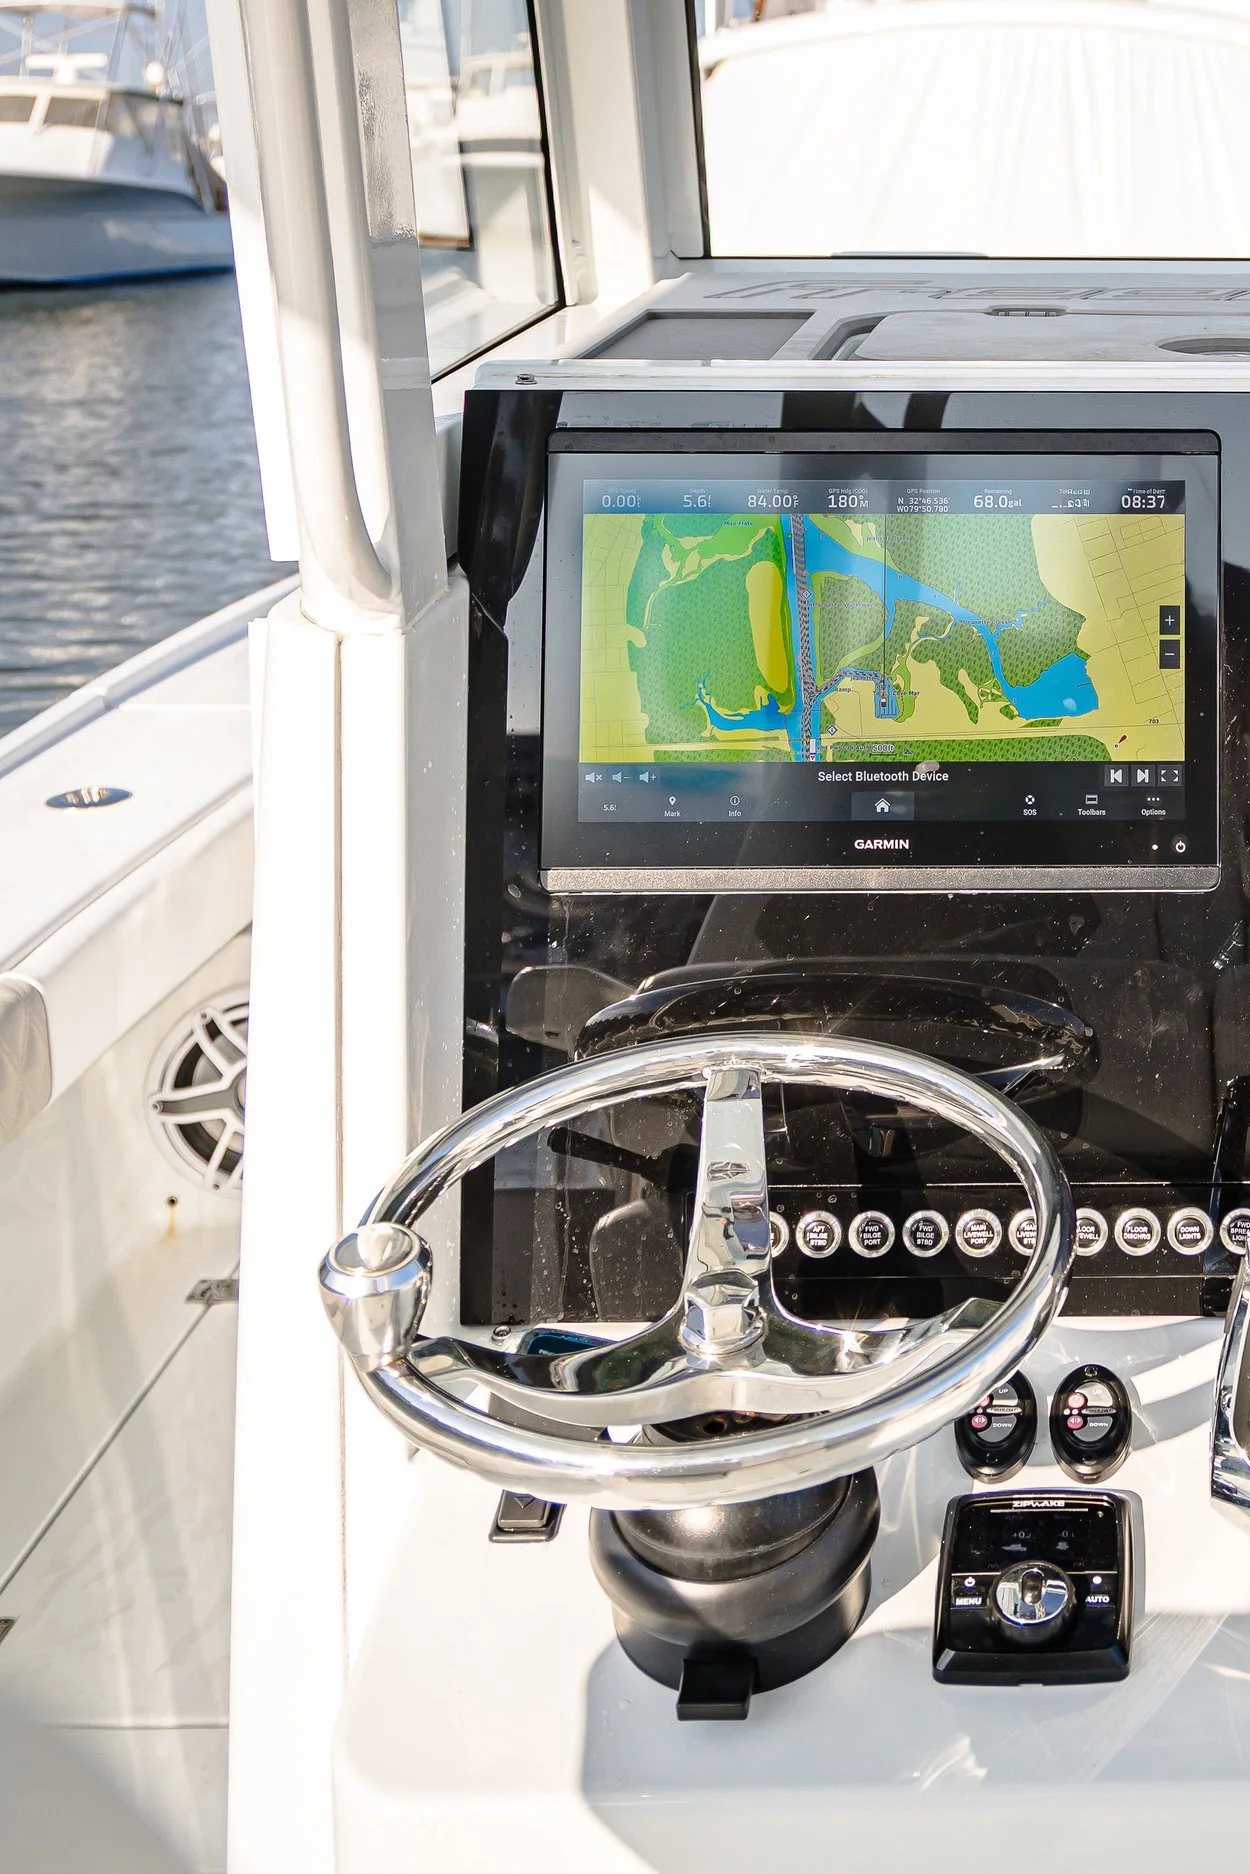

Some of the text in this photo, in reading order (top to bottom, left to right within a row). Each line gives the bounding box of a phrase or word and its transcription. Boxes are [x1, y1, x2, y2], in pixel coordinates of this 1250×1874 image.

[1121, 495, 1166, 509] 08:37
[818, 771, 949, 781] Select Bluetooth Device
[1023, 808, 1037, 816] SOS
[1077, 808, 1106, 816] Toolbars
[1141, 808, 1166, 818] Options
[854, 839, 910, 849] GARMIN
[1012, 1500, 1065, 1508] ZIPWAKE
[955, 1597, 982, 1606] MENU
[1085, 1595, 1110, 1604] AUTO
